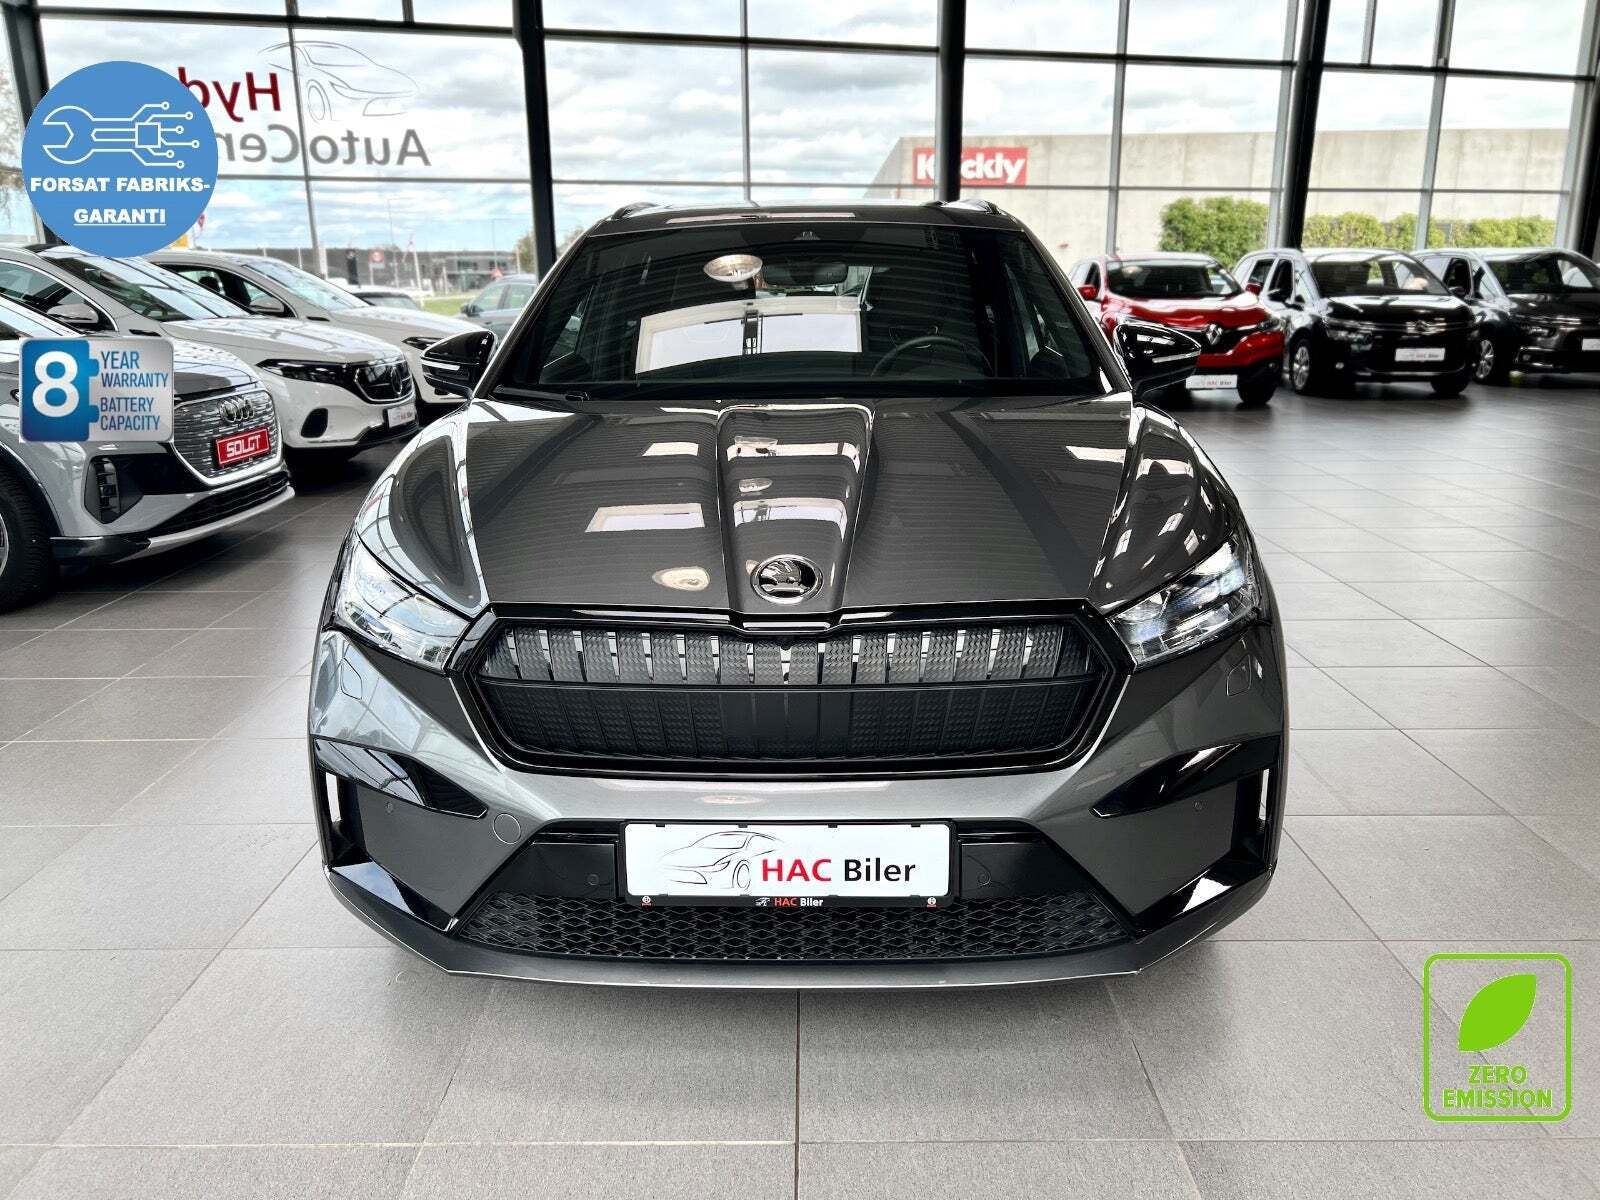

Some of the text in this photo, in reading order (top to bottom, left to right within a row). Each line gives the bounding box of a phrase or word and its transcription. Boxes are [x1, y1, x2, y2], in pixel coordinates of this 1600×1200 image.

[226, 434, 261, 458] SOLGT
[762, 857, 916, 882] HAC Biler
[774, 897, 824, 907] HAC Biler
